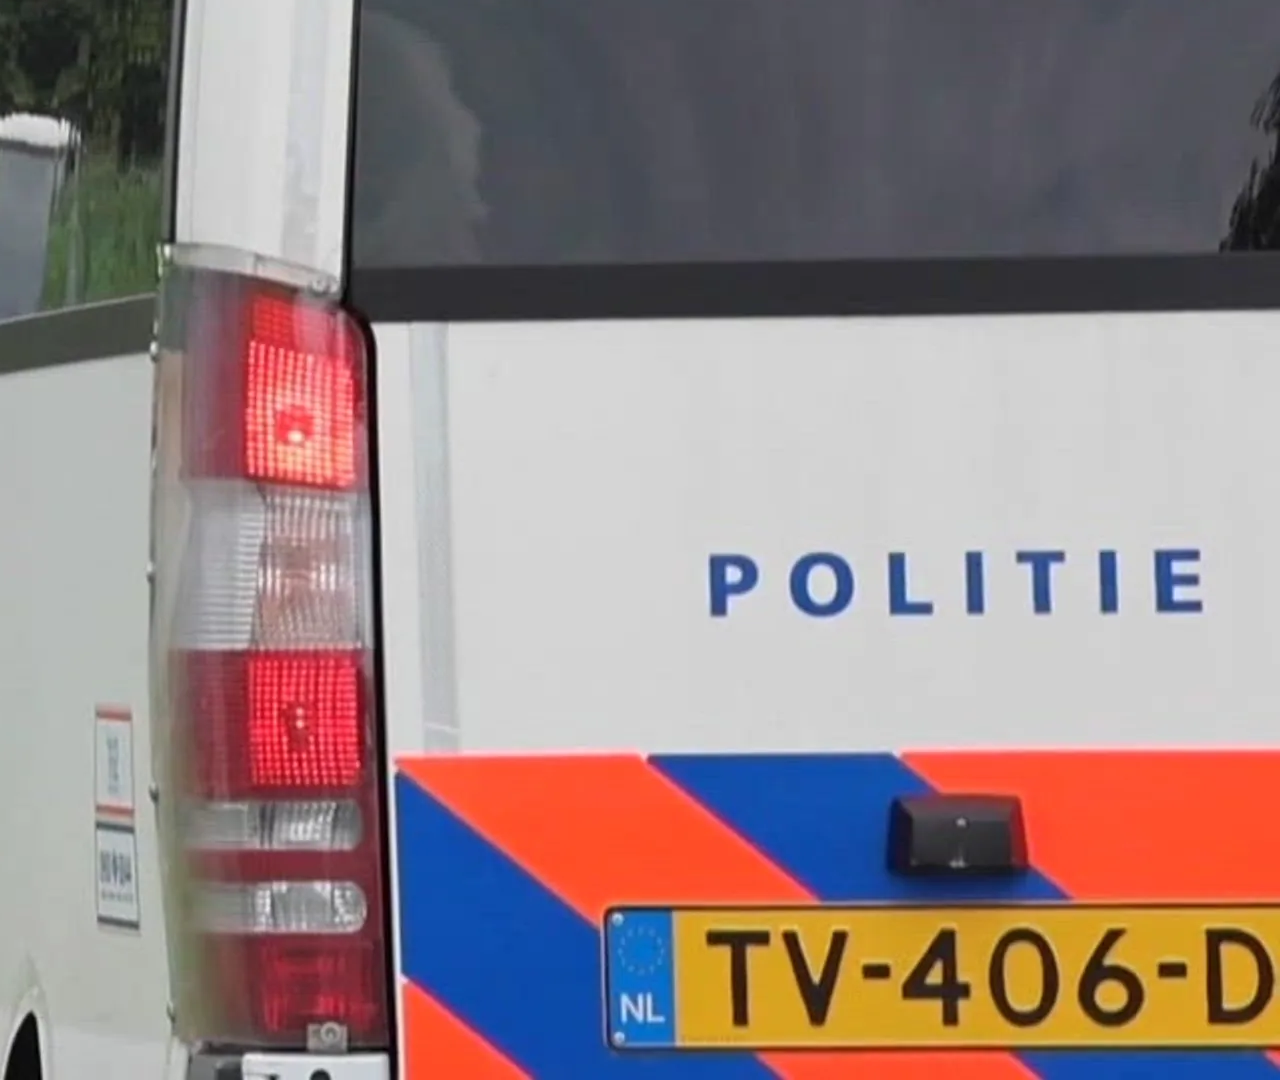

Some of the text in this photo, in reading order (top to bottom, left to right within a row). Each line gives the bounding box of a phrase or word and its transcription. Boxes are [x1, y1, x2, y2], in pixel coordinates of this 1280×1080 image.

[707, 548, 1204, 618] POLITIE
[620, 993, 666, 1024] NL
[705, 927, 1275, 1028] TV-406-D
